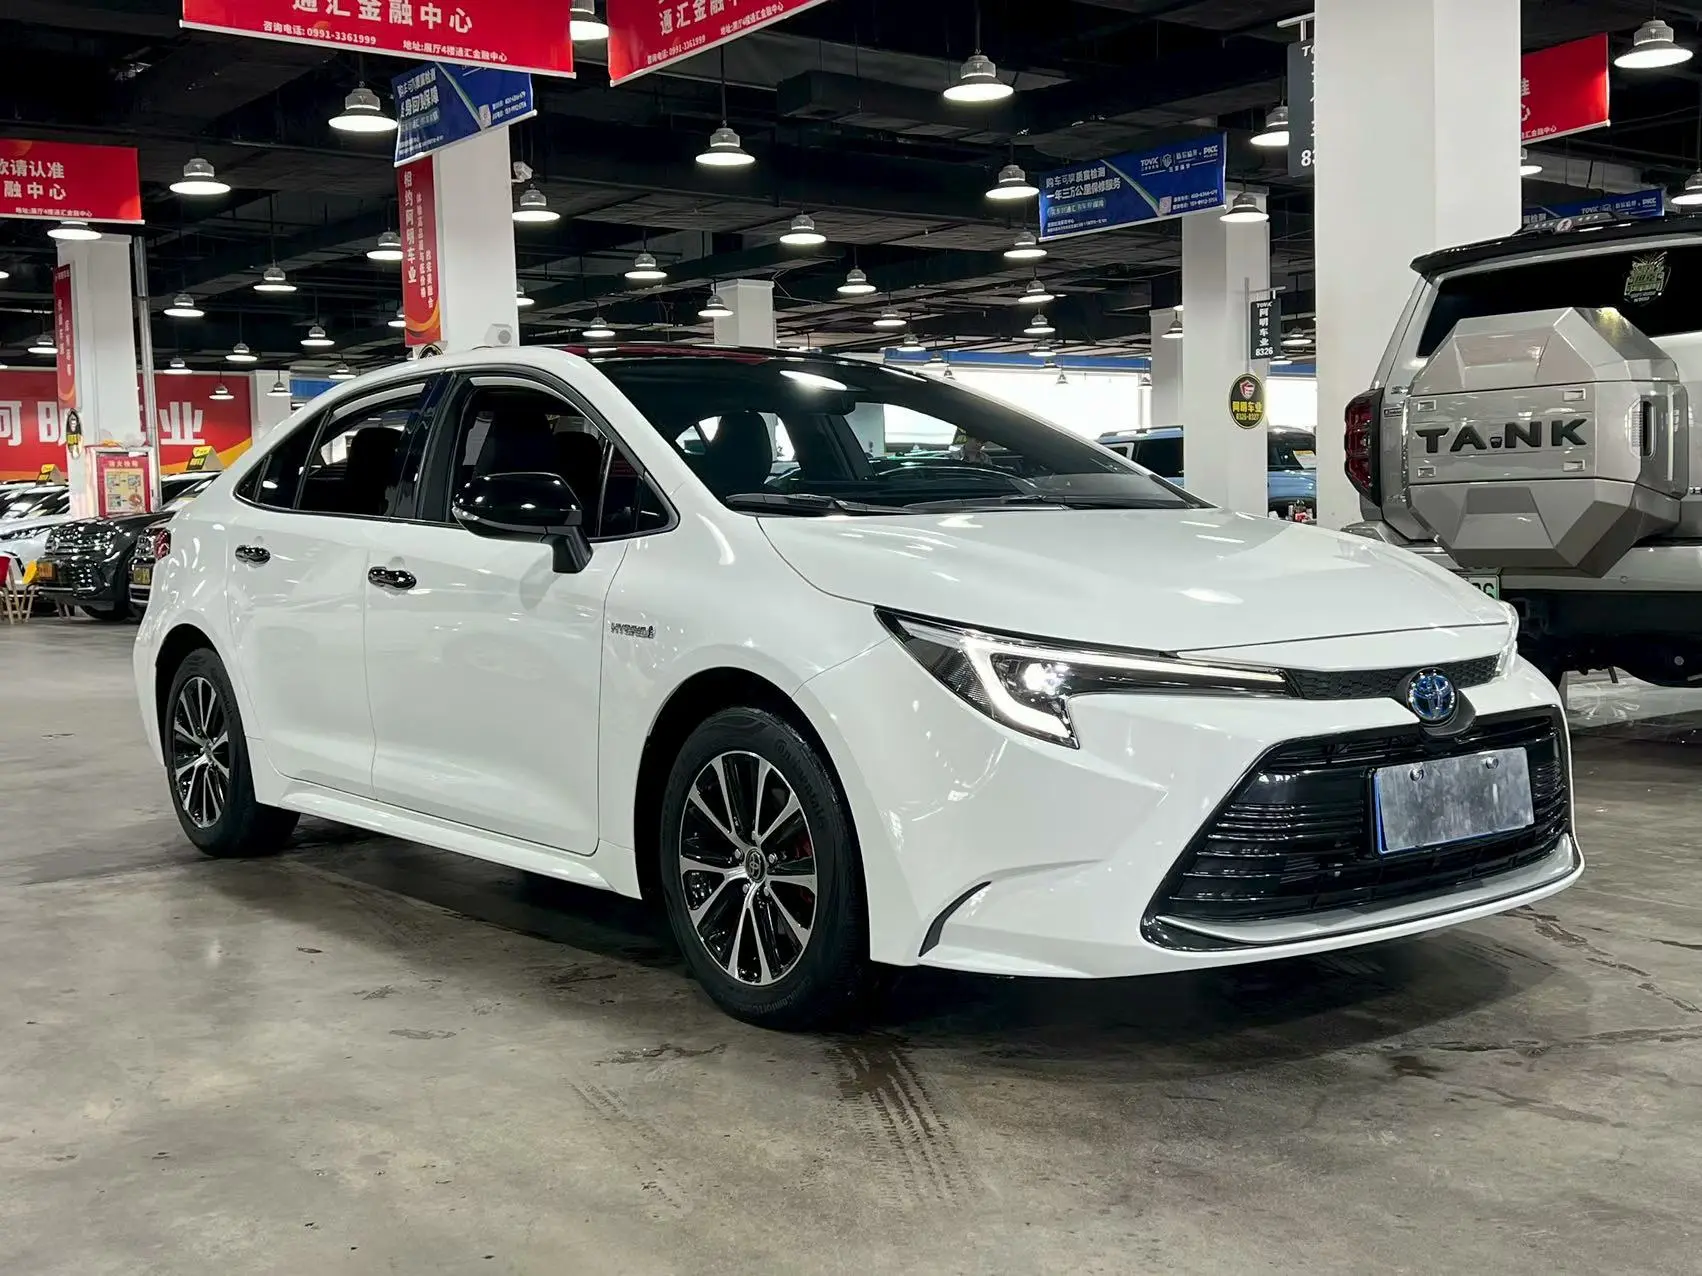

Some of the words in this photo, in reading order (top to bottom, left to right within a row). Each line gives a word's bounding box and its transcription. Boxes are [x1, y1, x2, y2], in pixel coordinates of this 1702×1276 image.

[306, 27, 377, 45] 0991-3361999
[1255, 346, 1274, 357] 8326
[1415, 418, 1588, 454] TANK
